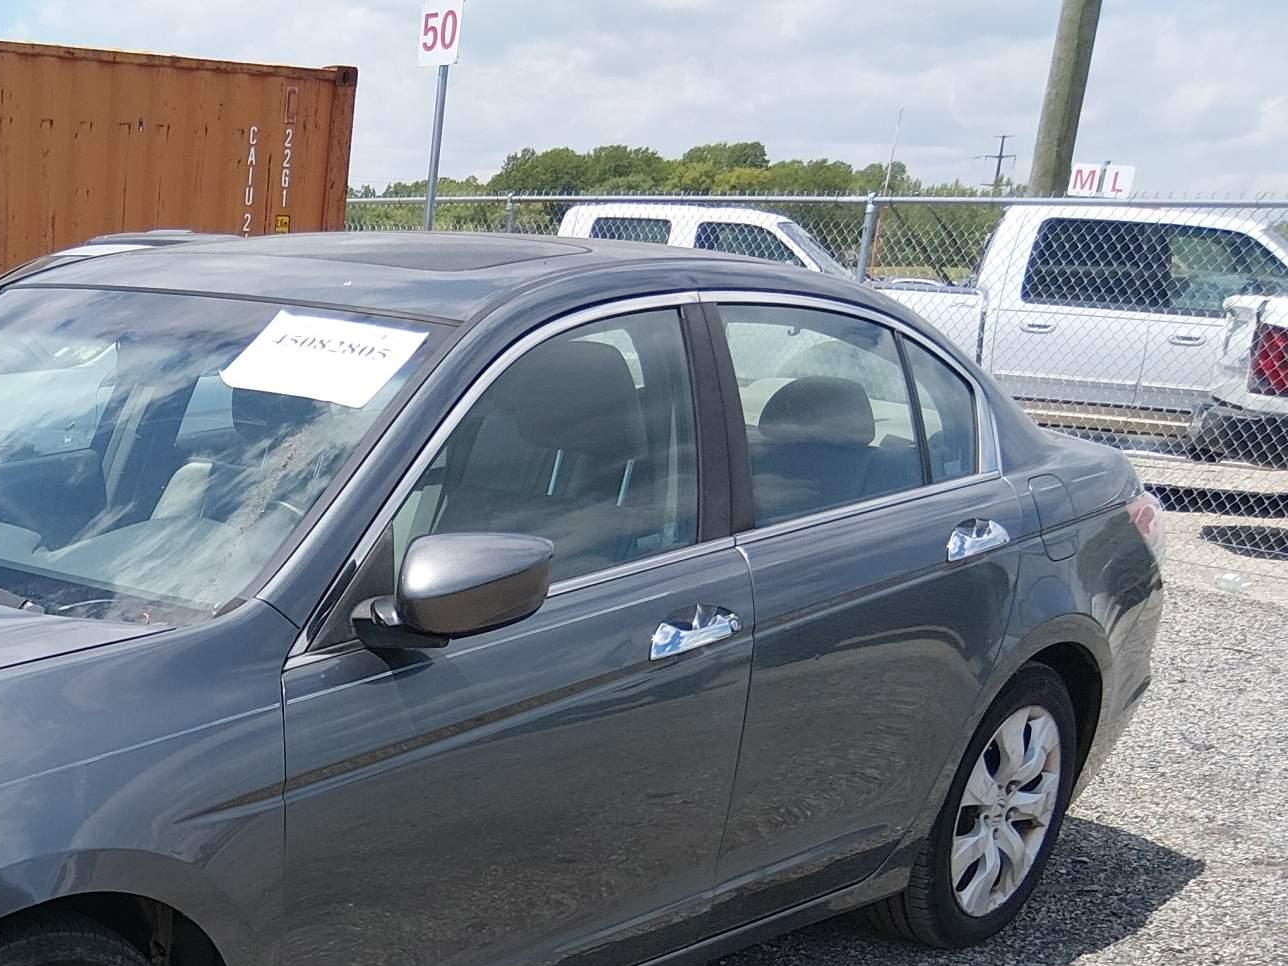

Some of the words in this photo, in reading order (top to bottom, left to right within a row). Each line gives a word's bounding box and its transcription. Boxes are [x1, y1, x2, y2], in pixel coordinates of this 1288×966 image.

[422, 9, 458, 52] 50
[245, 125, 258, 206] CAIU
[280, 128, 293, 208] 22G1
[1072, 168, 1097, 191] M
[1110, 170, 1124, 193] L
